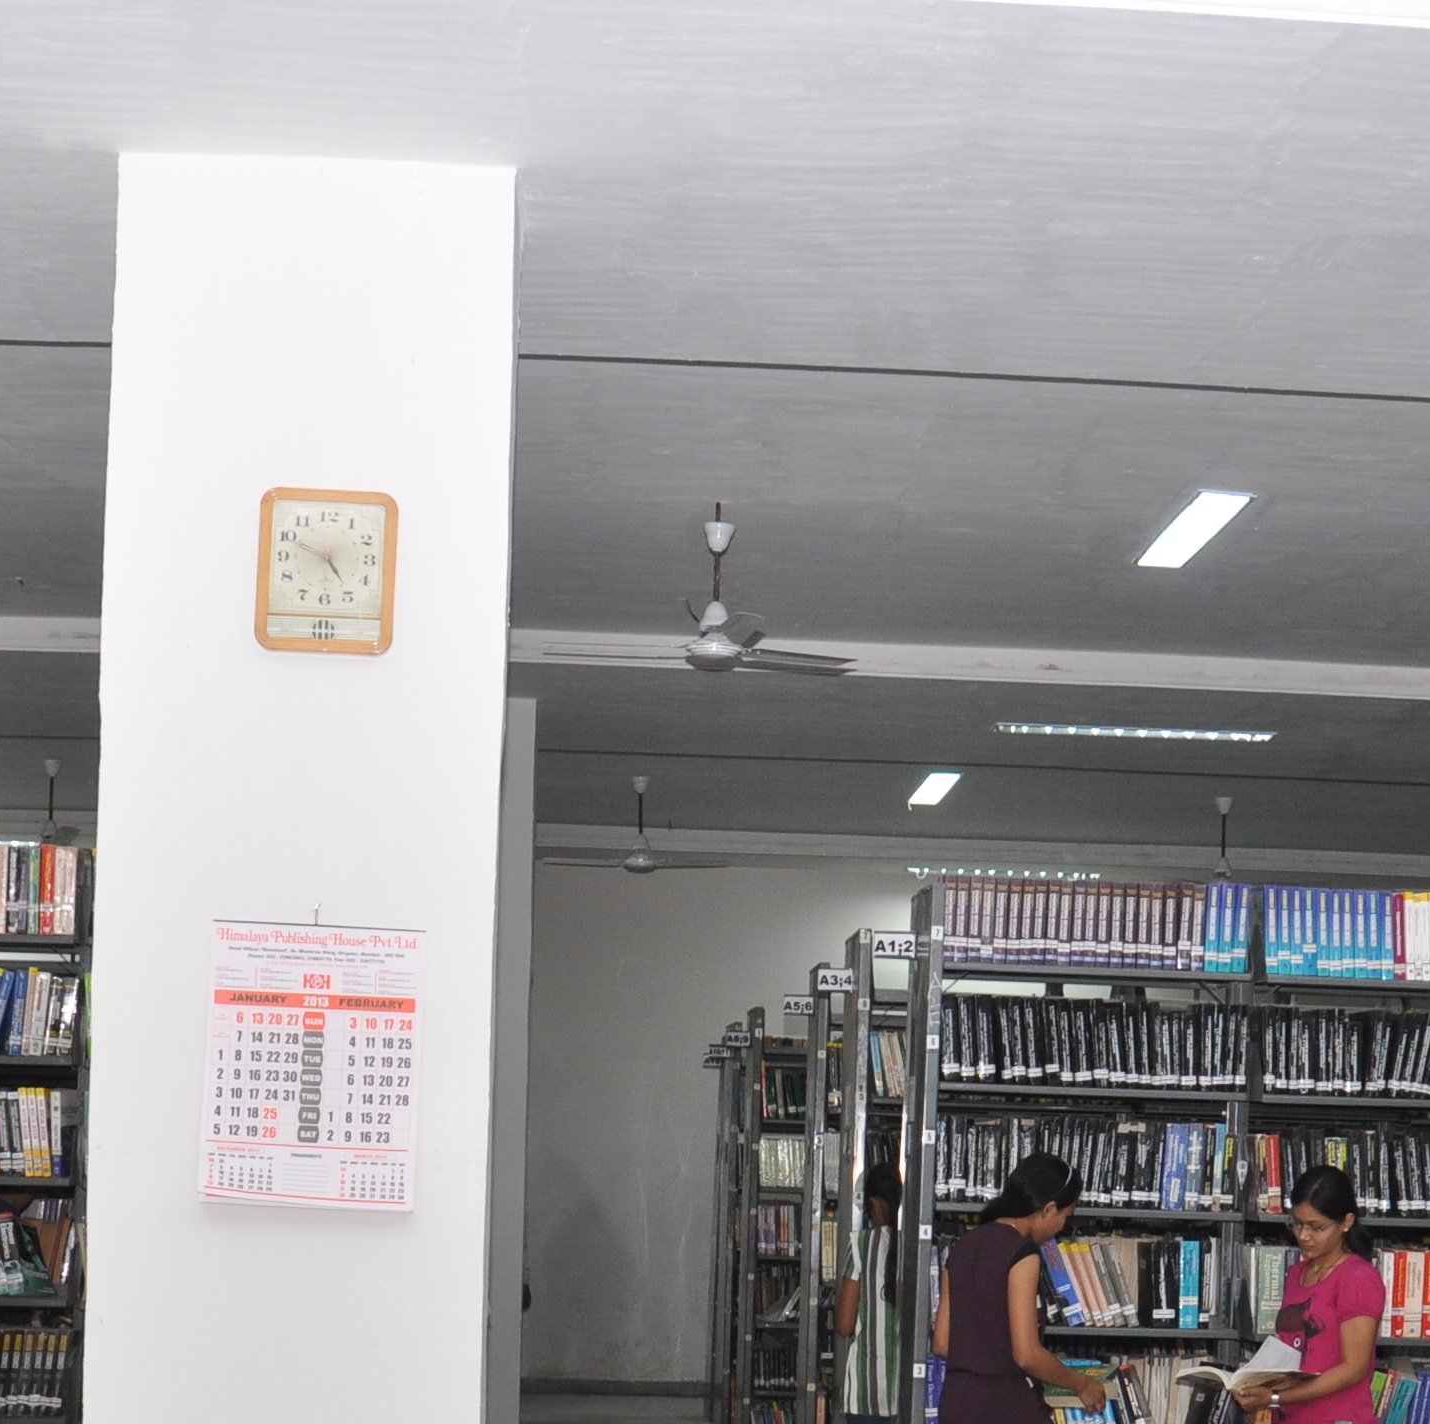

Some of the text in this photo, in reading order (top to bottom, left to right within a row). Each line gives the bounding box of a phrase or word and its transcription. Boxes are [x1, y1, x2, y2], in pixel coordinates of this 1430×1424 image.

[295, 516, 309, 527] 11
[321, 511, 339, 522] 12
[348, 518, 354, 529] 1
[280, 530, 297, 542] 10
[361, 534, 373, 546] 2
[278, 550, 289, 562] 9
[364, 554, 376, 566] 3
[281, 571, 293, 582] 8
[359, 575, 370, 585] 4
[298, 589, 309, 601] 7
[319, 594, 331, 605] 6
[342, 591, 354, 603] 5
[216, 928, 418, 949] Himalaya Publishing House Pvt. Ltd.
[874, 940, 913, 956] A1;2
[819, 975, 852, 987] A3;4
[230, 993, 404, 1008] JANUARY 2013 FEBRUARY
[783, 1001, 812, 1012] A5;6
[237, 1011, 243, 1023] 6
[252, 1012, 264, 1024] 13
[268, 1013, 282, 1025] 20
[287, 1014, 299, 1025] 27
[350, 1017, 357, 1029] 3
[365, 1018, 377, 1030] 10
[384, 1019, 394, 1030] 17
[399, 1019, 412, 1031] 24
[237, 1031, 242, 1042] 7
[251, 1031, 263, 1043] 14
[269, 1032, 280, 1043] 21
[285, 1033, 299, 1045] 28
[349, 1036, 356, 1047] 4
[366, 1037, 375, 1048] 11
[382, 1038, 394, 1049] 18
[398, 1038, 412, 1050] 25
[219, 1049, 223, 1060] 1
[235, 1050, 241, 1061] 8
[251, 1051, 262, 1062] 15
[267, 1051, 280, 1062] 22
[284, 1052, 298, 1064] 29
[348, 1055, 355, 1067] 5
[364, 1056, 375, 1067] 12
[382, 1056, 392, 1068] 19
[397, 1057, 411, 1069] 26
[217, 1068, 223, 1079] 2
[234, 1068, 241, 1080] 9
[249, 1069, 261, 1081] 16
[266, 1070, 279, 1081] 23
[283, 1071, 297, 1082] 30
[347, 1074, 354, 1085] 6
[362, 1075, 374, 1086] 13
[379, 1075, 392, 1087] 20
[397, 1076, 409, 1087] 27
[216, 1087, 222, 1098] 3
[231, 1087, 242, 1098] 10
[249, 1089, 259, 1100] 17
[265, 1089, 278, 1100] 24
[283, 1090, 295, 1101] 31
[347, 1093, 352, 1104] 7
[362, 1094, 373, 1105] 14
[379, 1094, 391, 1105] 21
[396, 1095, 409, 1106] 28
[215, 1105, 221, 1116] 4
[230, 1106, 240, 1117] 11
[247, 1107, 258, 1118] 18
[263, 1108, 277, 1120] 25
[329, 1111, 333, 1122] 1
[346, 1112, 352, 1123] 8
[360, 1113, 372, 1124] 15
[377, 1113, 391, 1124] 22
[214, 1124, 220, 1135] 5
[228, 1124, 240, 1135] 12
[245, 1125, 258, 1137] 19
[262, 1126, 276, 1138] 26
[327, 1130, 333, 1141] 2
[345, 1131, 351, 1142] 9
[360, 1131, 372, 1143] 16
[376, 1132, 390, 1143] 23
[0, 1223, 10, 1259] Electronics
[1272, 1254, 1281, 1299] Thermal
